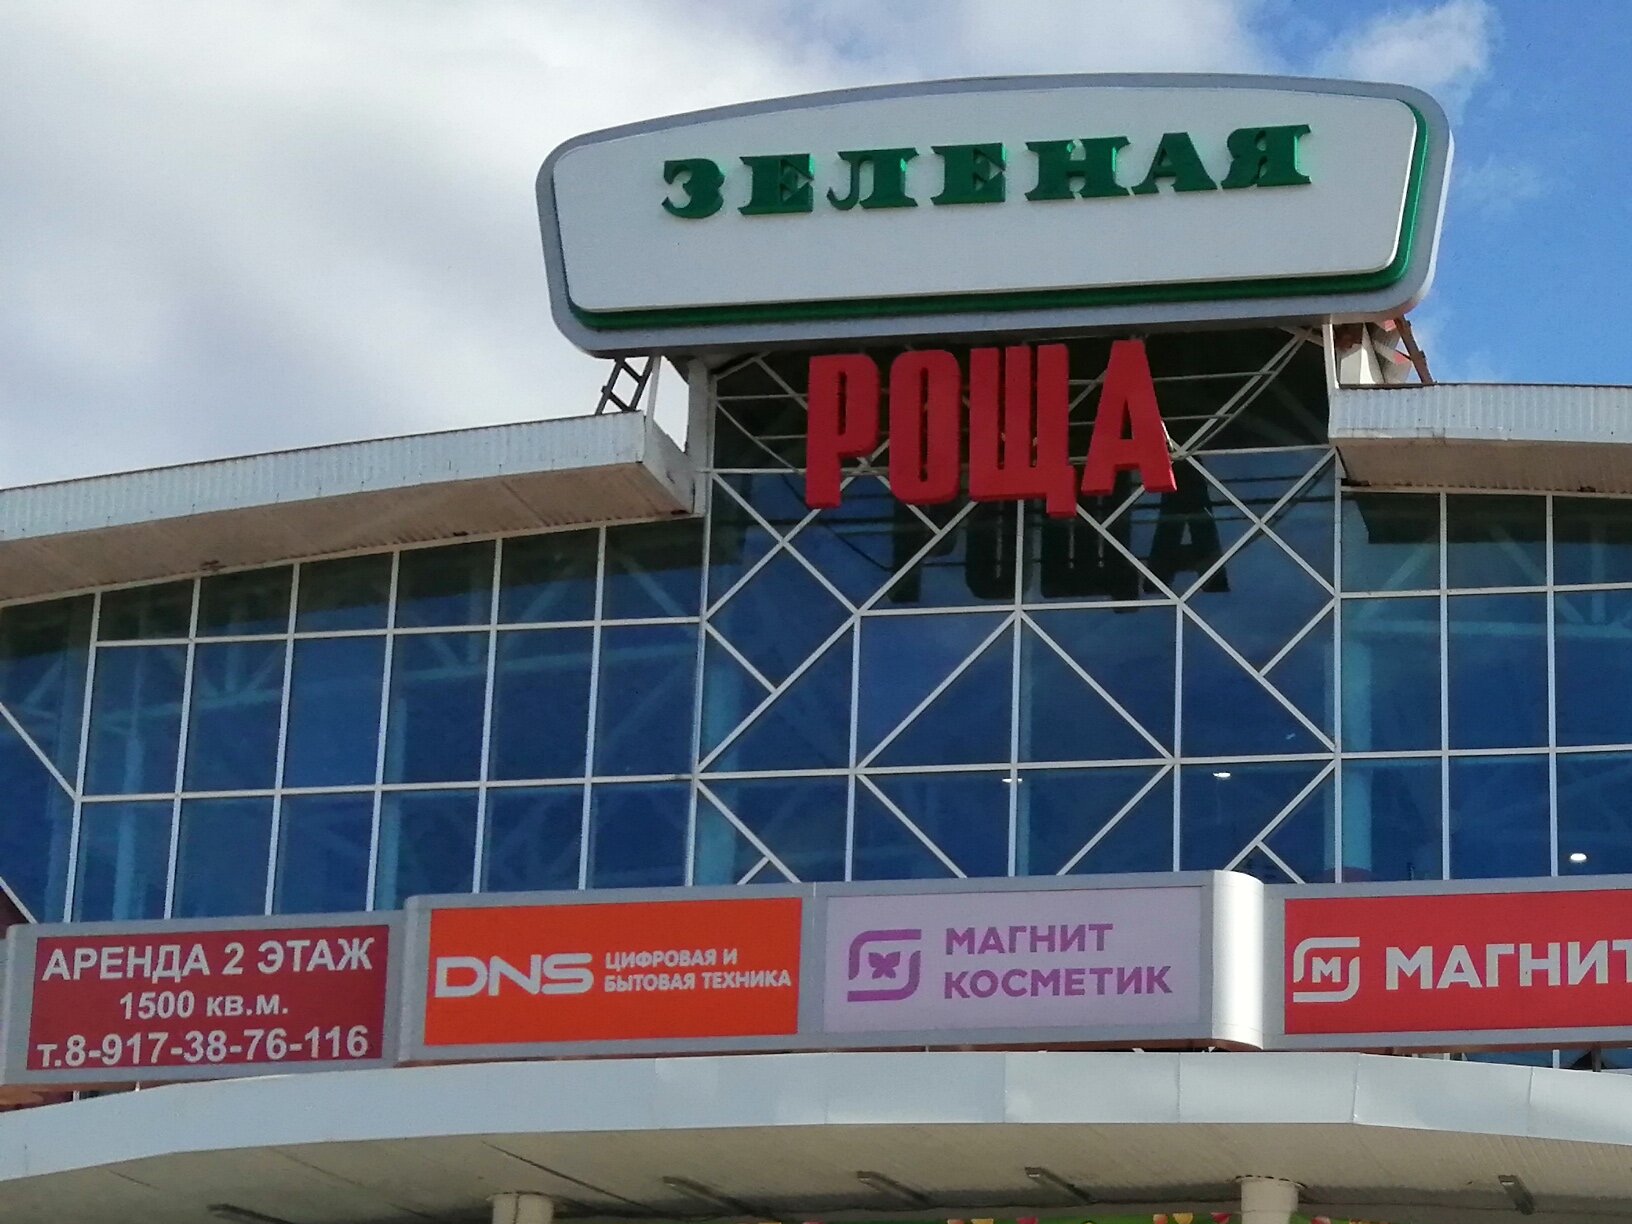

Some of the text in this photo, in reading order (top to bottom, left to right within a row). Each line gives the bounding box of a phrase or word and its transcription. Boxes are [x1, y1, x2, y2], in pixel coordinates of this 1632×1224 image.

[661, 123, 1313, 219] ЗЕЛЕНАЯ
[805, 339, 1177, 518] РОЩА
[945, 923, 1114, 956] МАГНИТ
[42, 937, 375, 984] АРЕНДА 2 ЭТАЖ
[433, 953, 593, 998] DNS
[604, 948, 739, 972] ЦИФРОВАЯ И
[603, 967, 792, 994] БЫТОВАЯ ТЕХНИКА
[944, 965, 1174, 1000] КОСМЕТИК
[120, 990, 196, 1020] 1500
[36, 1025, 369, 1069] т.8-917-38-76-116
